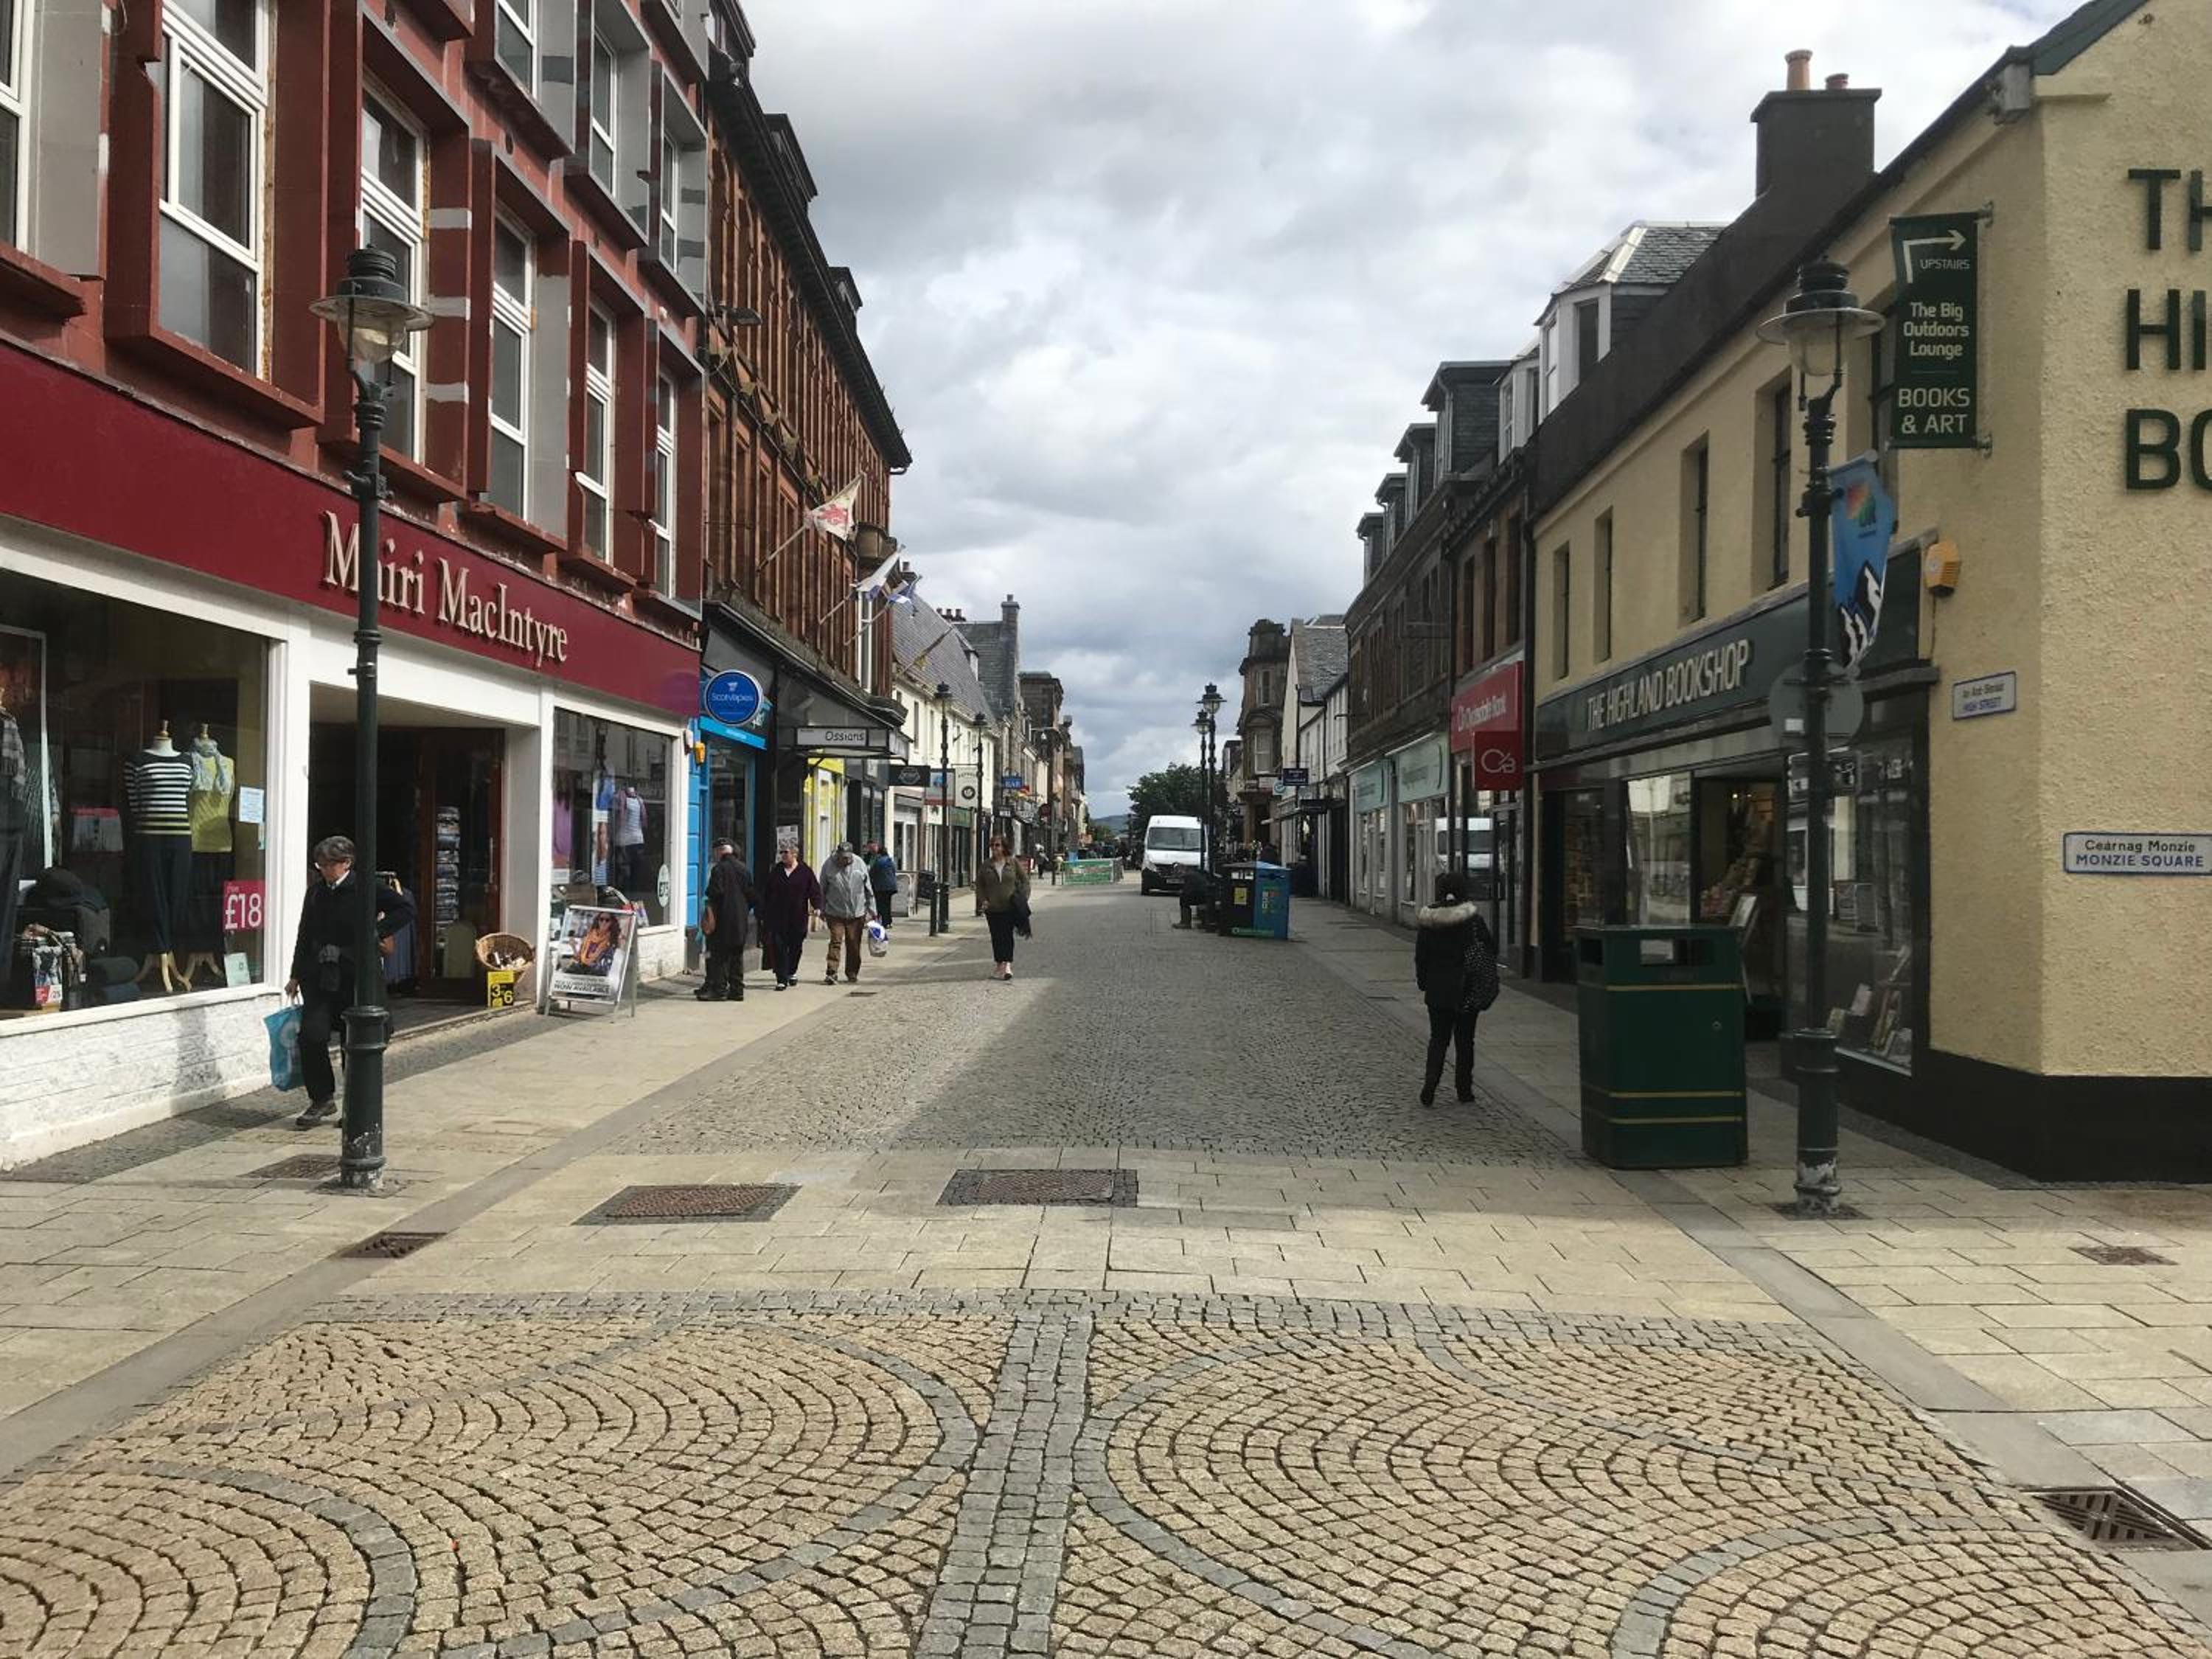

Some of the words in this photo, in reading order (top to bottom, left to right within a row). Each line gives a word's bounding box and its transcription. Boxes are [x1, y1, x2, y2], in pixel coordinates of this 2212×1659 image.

[1920, 259, 1970, 270] UPSTAIRS
[1910, 302, 1936, 318] The
[1940, 302, 1964, 322] Big
[1903, 321, 1969, 337] Outdoors
[1910, 340, 1963, 360] Lounge
[1899, 388, 1970, 407] BOOKS
[1901, 414, 1916, 434] &
[1924, 414, 1967, 434] ART
[437, 557, 568, 667] MacIntyre
[1587, 692, 1605, 732] THE
[1606, 670, 1663, 726] HIGHLAND
[1666, 639, 1750, 709] BOOKSHOP
[825, 731, 865, 741] Ossians
[1005, 780, 1020, 788] BAR
[2148, 841, 2195, 852] Monzie
[2076, 854, 2136, 866] MONZIE
[2140, 855, 2204, 867] SQUARE
[225, 893, 262, 929] £18
[492, 984, 501, 997] 3
